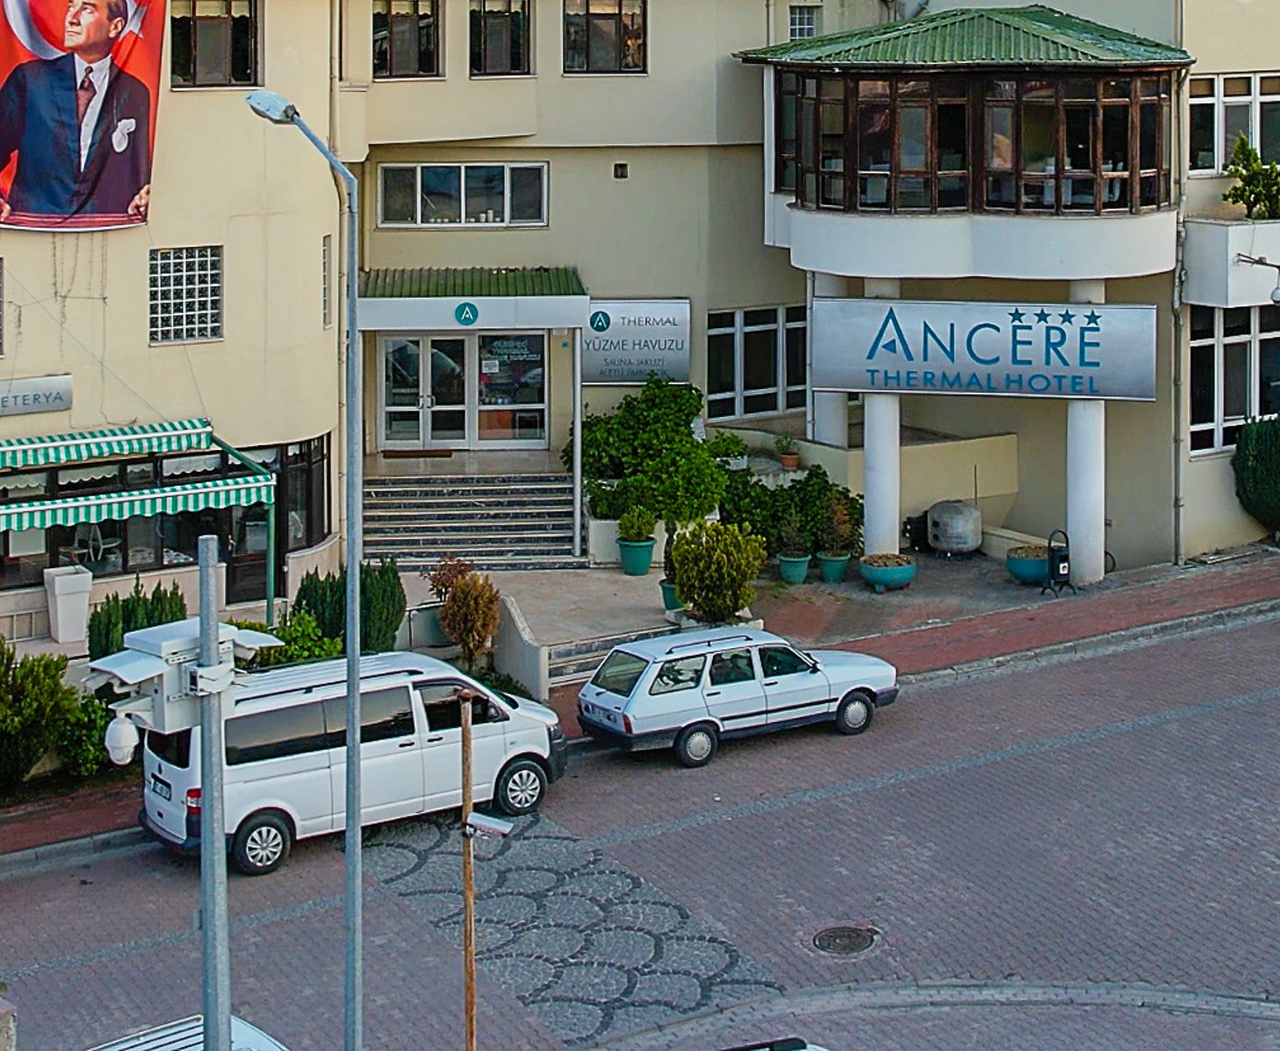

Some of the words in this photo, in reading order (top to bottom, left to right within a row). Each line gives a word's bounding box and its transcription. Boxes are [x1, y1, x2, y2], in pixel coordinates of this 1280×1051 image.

[620, 316, 678, 327] THERMAL
[584, 336, 628, 351] YÜZME
[632, 339, 685, 351] HAVUZU
[866, 306, 1101, 368] ANCERE
[866, 369, 999, 392] THERMAL
[1006, 373, 1100, 394] HOTEL
